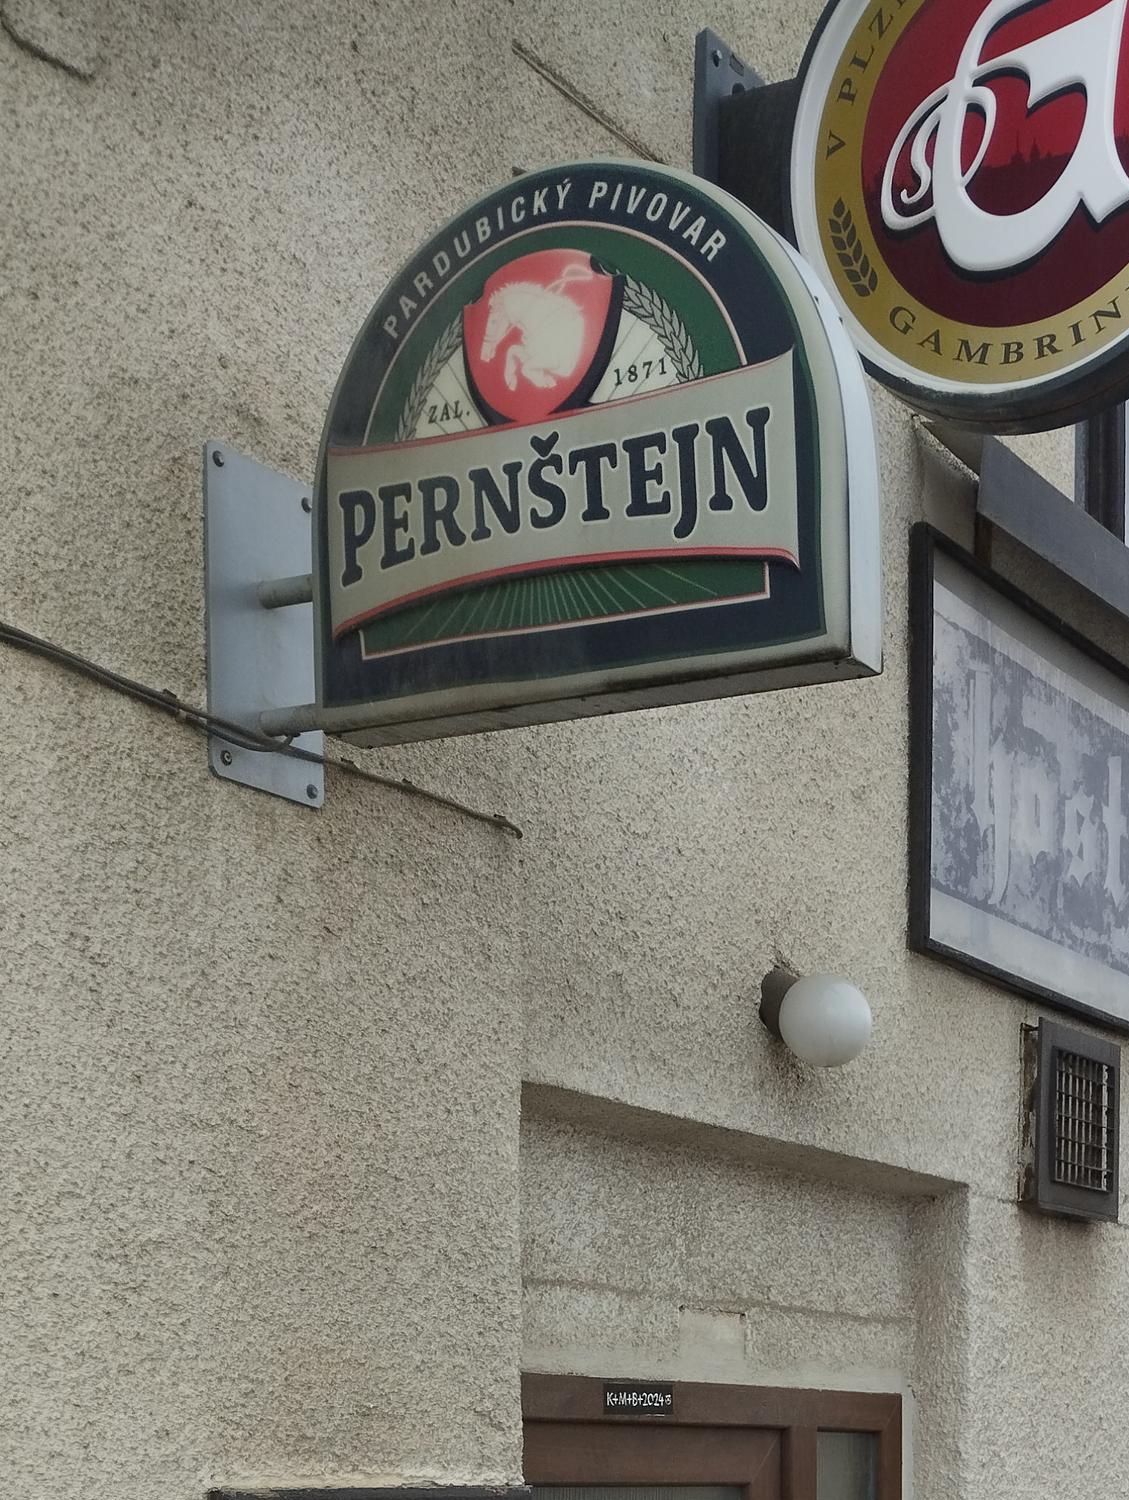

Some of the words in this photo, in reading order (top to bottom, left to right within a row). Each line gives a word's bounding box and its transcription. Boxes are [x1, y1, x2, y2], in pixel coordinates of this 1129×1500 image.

[826, 129, 847, 161] V
[382, 177, 573, 341] PARDUBICKÝ
[588, 181, 729, 264] PIVOVAR
[428, 400, 470, 424] ZAL.
[614, 358, 667, 386] 1871
[338, 405, 772, 588] PERNŠTEJN
